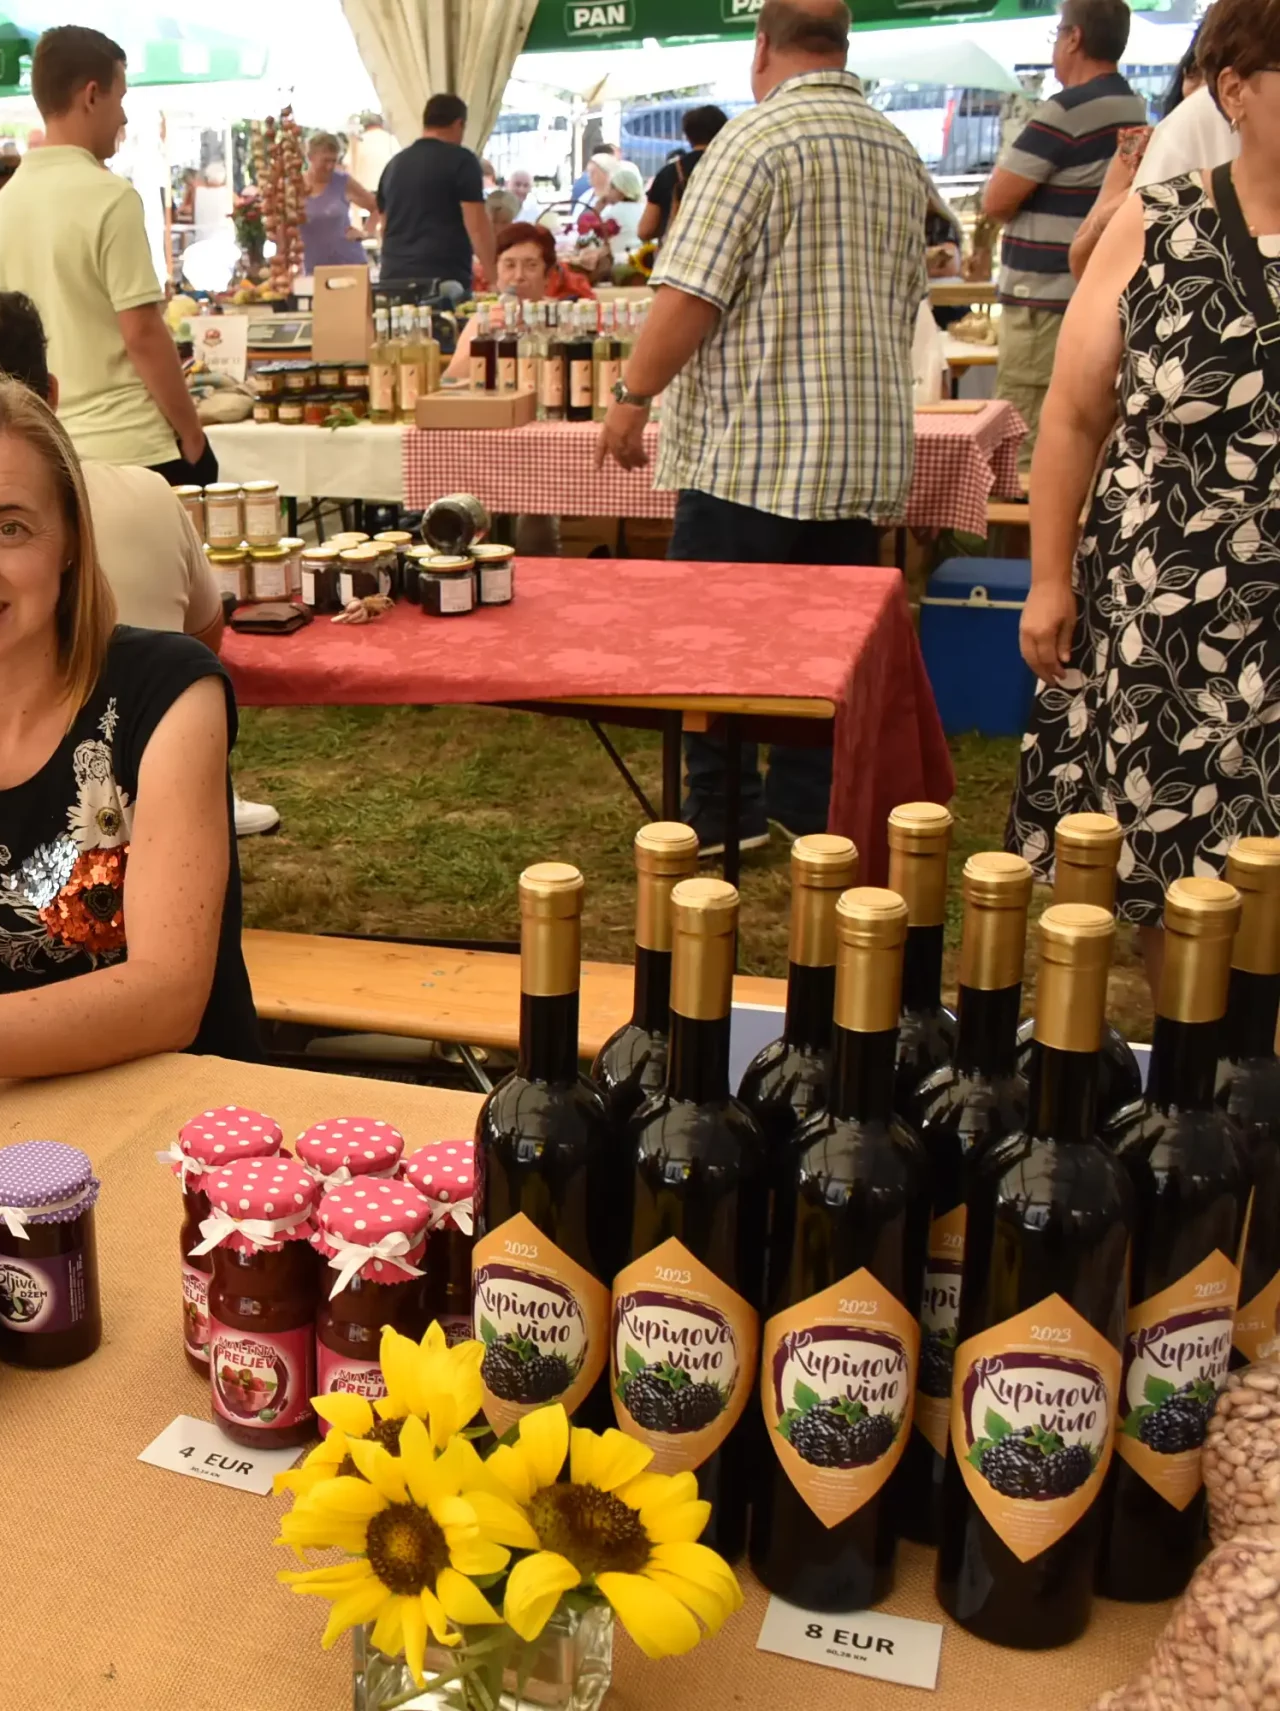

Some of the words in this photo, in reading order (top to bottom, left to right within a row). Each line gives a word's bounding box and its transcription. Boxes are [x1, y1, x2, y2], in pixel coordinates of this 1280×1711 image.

[573, 5, 625, 28] PAN
[732, 0, 764, 14] PA
[504, 1240, 538, 1258] 2023
[943, 1232, 964, 1247] 20
[655, 1266, 692, 1284] 2023
[20, 1289, 48, 1298] DŽEM
[474, 1266, 578, 1320] Kupinovo
[837, 1298, 878, 1315] 2023
[517, 1321, 570, 1343] vino
[618, 1294, 731, 1348] Kupinovo
[1029, 1325, 1072, 1342] 2023
[217, 1346, 277, 1369] PRELJEV
[668, 1347, 723, 1370] vino
[784, 1331, 907, 1384] Kupinovo
[1131, 1326, 1230, 1372] Kupino
[1200, 1354, 1228, 1381] vin
[846, 1379, 898, 1402] vino
[975, 1356, 1105, 1413] Kupinovo
[1040, 1409, 1096, 1432] vino
[178, 1446, 196, 1459] 4
[204, 1453, 254, 1475] EUR
[805, 1623, 823, 1639] 8
[833, 1629, 895, 1655] EUR
